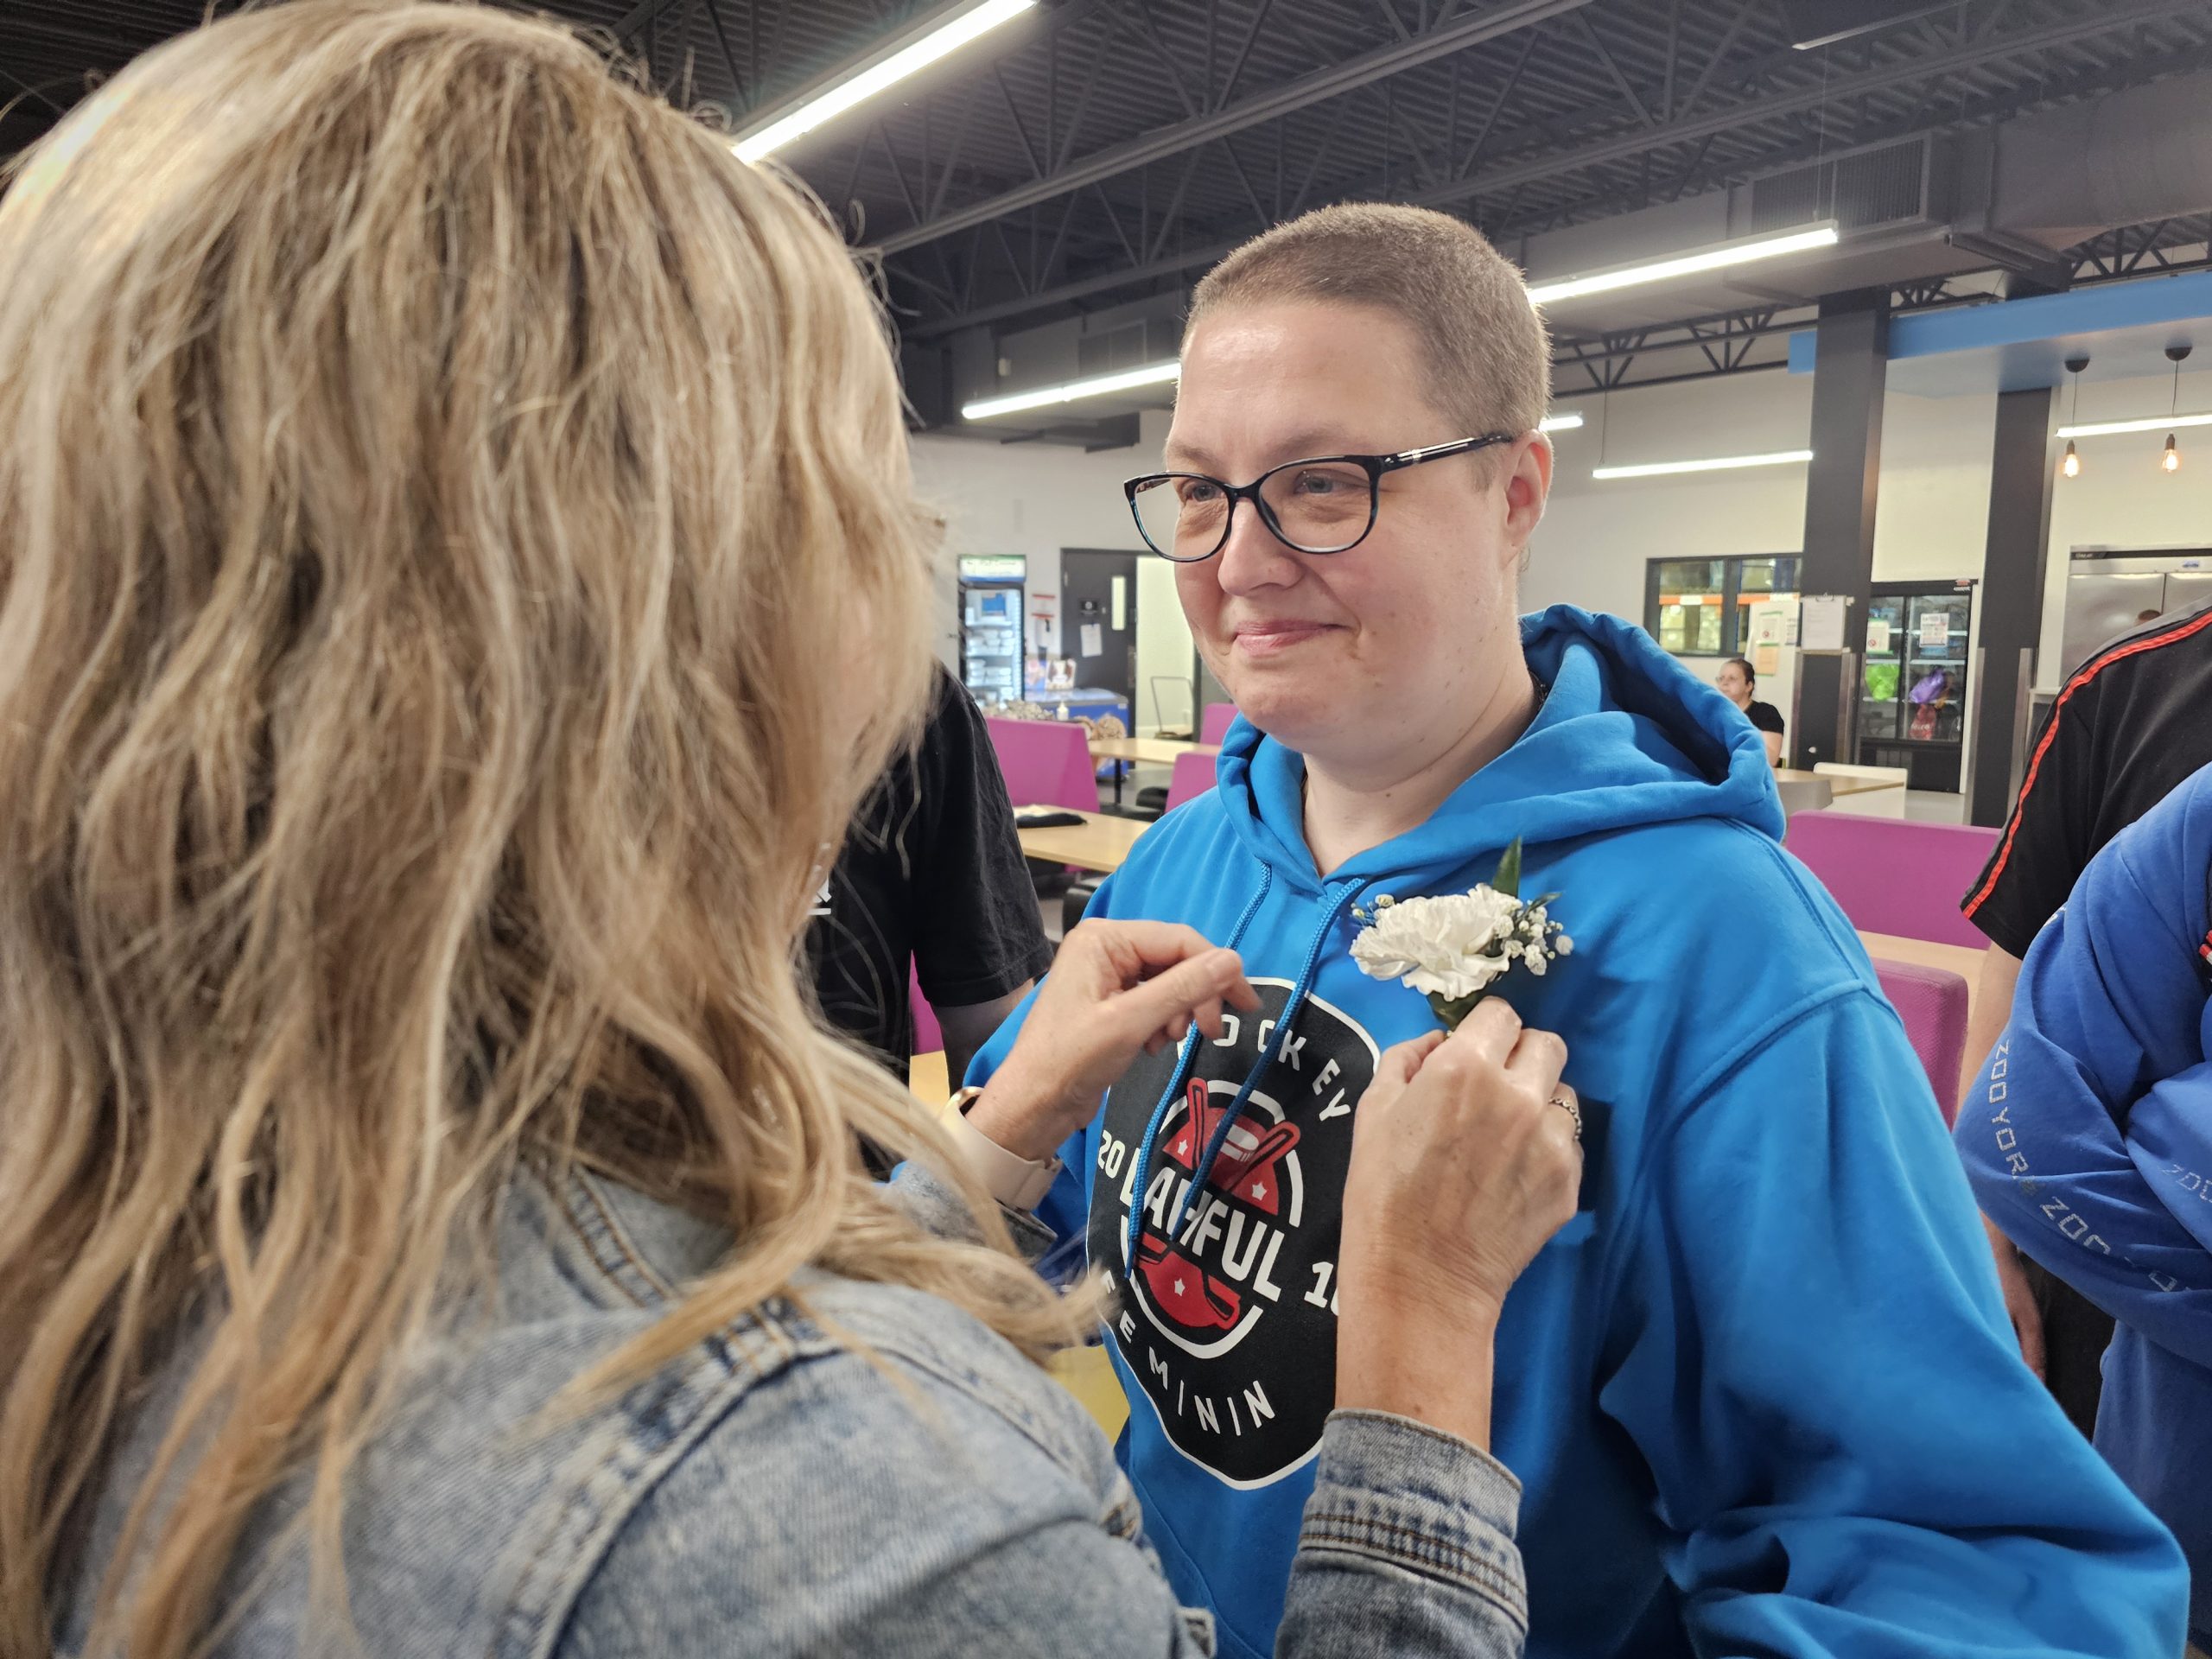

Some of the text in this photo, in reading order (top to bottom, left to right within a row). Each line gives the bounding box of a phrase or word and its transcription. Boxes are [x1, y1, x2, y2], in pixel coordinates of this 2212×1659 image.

[1177, 1013, 1351, 1122] OCKEY
[1097, 1129, 1126, 1179] 20
[1304, 1262, 1339, 1316] 1
